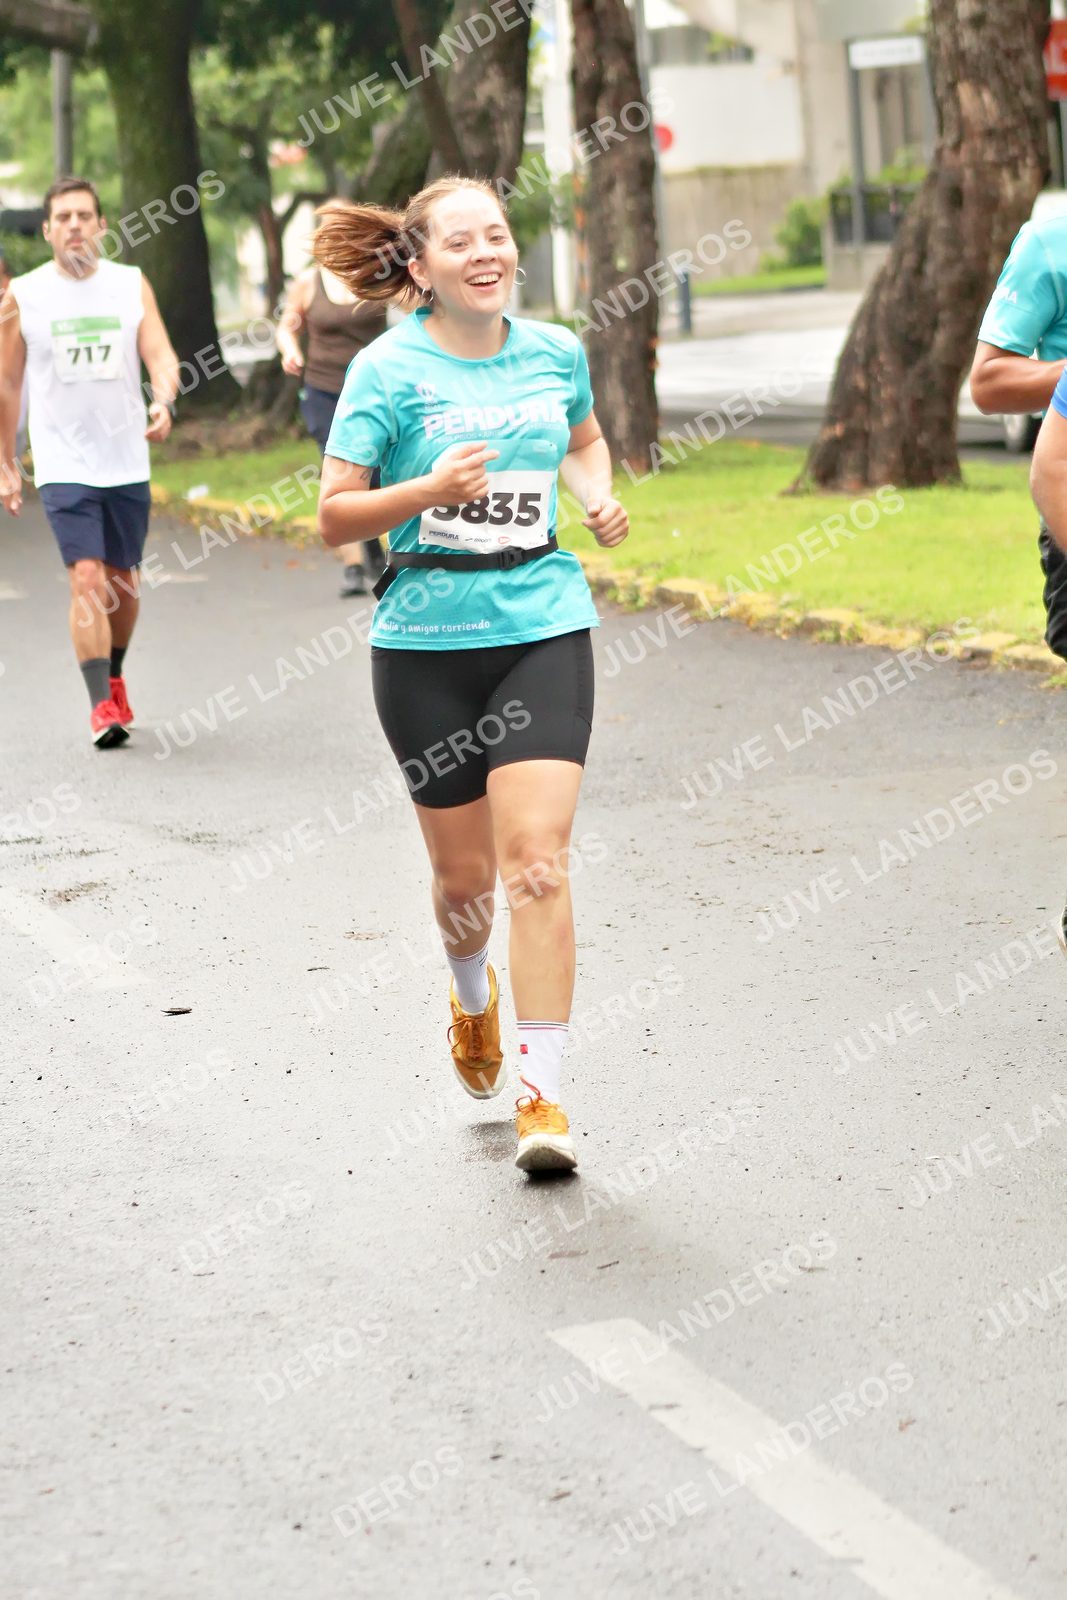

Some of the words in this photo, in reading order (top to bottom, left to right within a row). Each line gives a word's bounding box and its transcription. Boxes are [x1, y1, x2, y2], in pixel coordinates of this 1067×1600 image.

[67, 345, 111, 365] 717
[429, 530, 459, 540] PERDURA
[408, 624, 439, 635] amigos
[442, 619, 490, 632] corriendo
